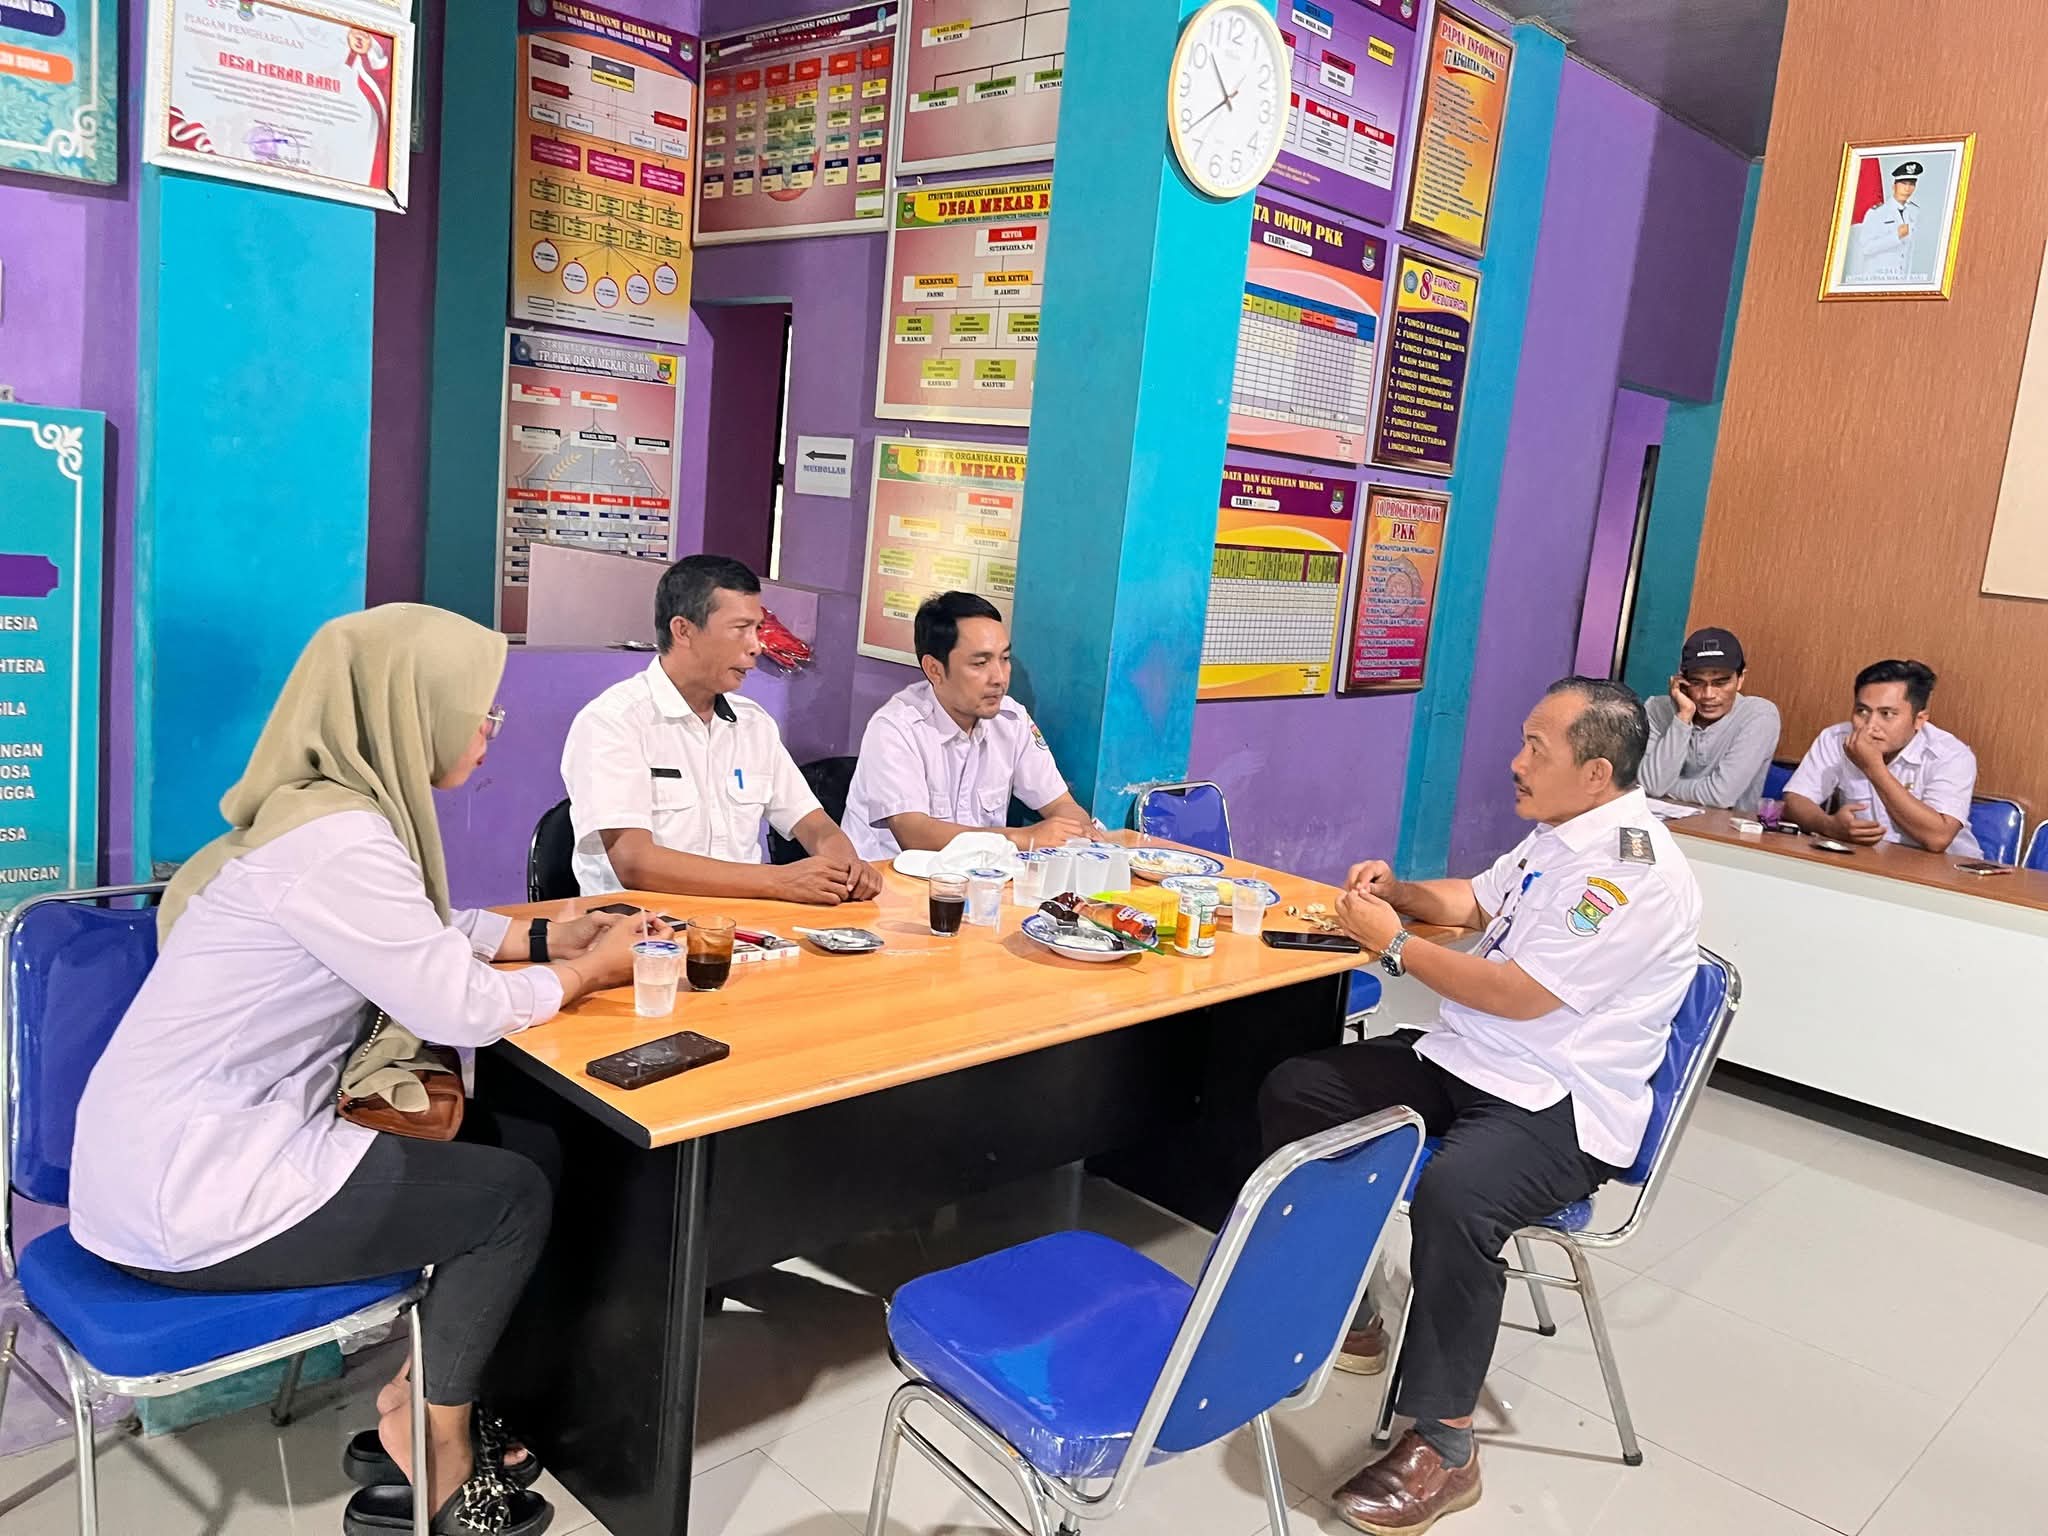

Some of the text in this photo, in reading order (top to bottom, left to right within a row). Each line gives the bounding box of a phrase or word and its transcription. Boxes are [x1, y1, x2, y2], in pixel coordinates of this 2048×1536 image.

[580, 8, 621, 30] MEKANISME
[622, 21, 656, 40] GERAKAN
[657, 32, 672, 46] PKK
[1210, 20, 1221, 48] 11
[1228, 16, 1246, 46] 12
[1188, 41, 1207, 69] 10
[1442, 22, 1505, 69] PAPAN INFORMASI
[219, 52, 341, 93] DESA MEKAR BARU
[1258, 64, 1272, 92] 2
[1180, 72, 1191, 97] 9
[1181, 108, 1193, 134] 8
[1259, 100, 1272, 125] 3
[1191, 138, 1203, 163] 7
[1247, 132, 1259, 154] 4
[1209, 154, 1223, 179] 6
[1230, 150, 1243, 174] 5
[938, 194, 1050, 217] DESA MEKAR B
[1274, 210, 1312, 237] UMUM
[1315, 224, 1344, 248] PKK
[1008, 274, 1029, 282] KETUA
[1420, 269, 1433, 300] 8
[1434, 275, 1460, 292] FUNGSI
[1431, 292, 1468, 313] KELUARGA
[1404, 317, 1425, 329] FUNGSI
[1402, 330, 1423, 342] FUNGSI
[1401, 342, 1422, 354] FUNGSI
[1423, 348, 1439, 358] CINTA
[1439, 353, 1452, 362] DAN
[552, 352, 572, 363] PKK
[575, 355, 596, 368] DESA
[598, 359, 627, 371] MEKAR
[629, 362, 650, 374] BARU
[1397, 367, 1418, 379] FUNGSI
[1399, 355, 1440, 371] KASIH SAYANG
[1395, 380, 1417, 391] FUNGSI
[1418, 385, 1452, 398] REPRODUKSI
[1392, 404, 1427, 418] SOSIALISASI
[1394, 392, 1415, 404] FUNGSI
[1442, 403, 1455, 412] DAN
[1391, 417, 1412, 428] FUNGSI
[1389, 429, 1410, 440] FUNGSI
[1411, 433, 1447, 447] PELESTARIAN
[955, 453, 1001, 463] ORGANISASI
[1388, 442, 1425, 456] LINGKUNGAN
[917, 459, 1017, 481] DESA MEKAR
[1223, 471, 1324, 491] DATA DAN KEGIATAN WARGA
[1256, 486, 1272, 496] PKK
[1376, 500, 1386, 518] 10
[1387, 500, 1419, 520] PROGRAM
[1392, 523, 1416, 541] PKK
[0, 743, 43, 758] NGAN
[0, 765, 31, 779] OSA
[0, 786, 35, 800] GGA
